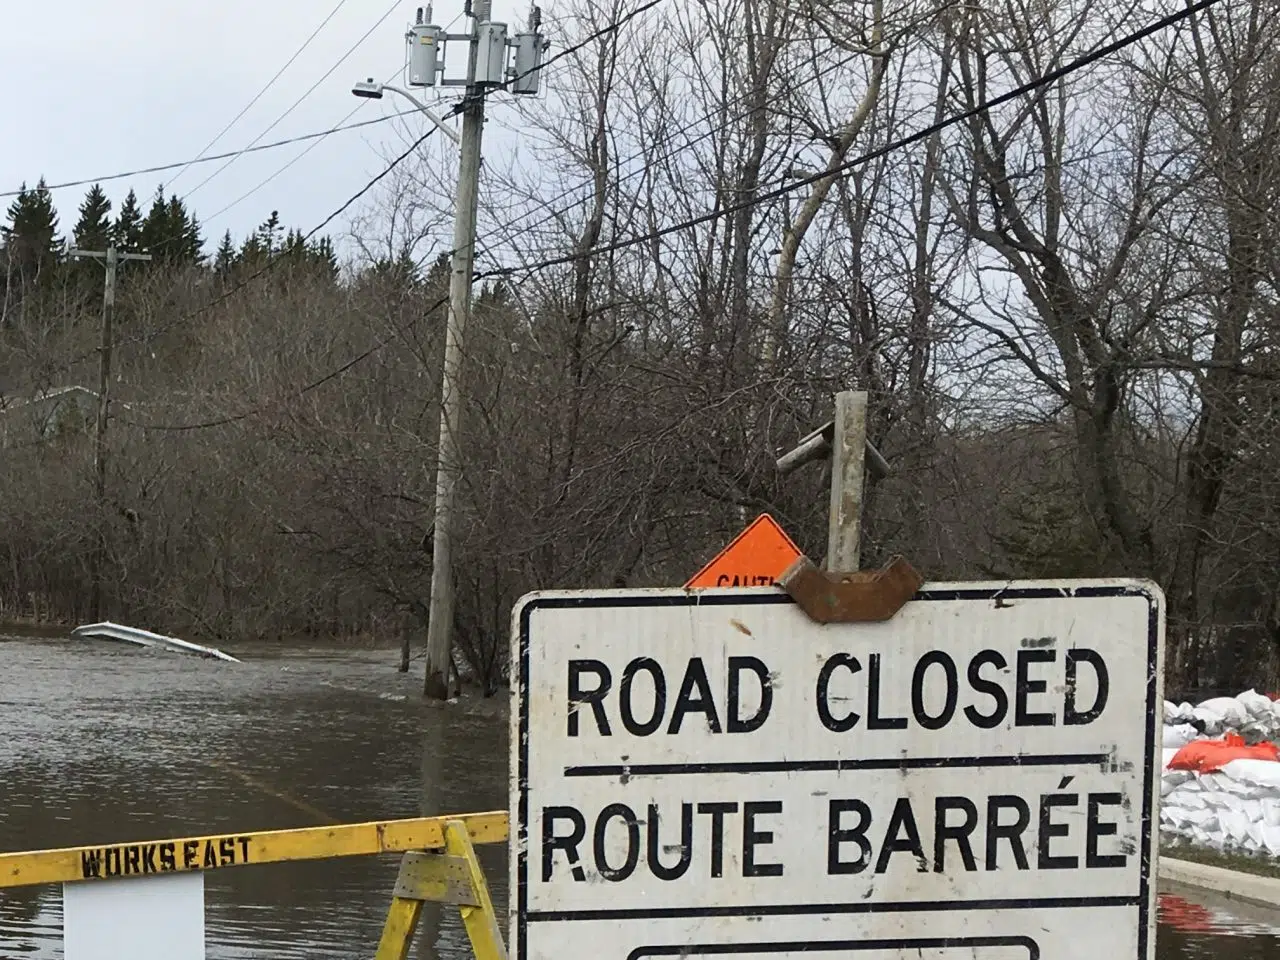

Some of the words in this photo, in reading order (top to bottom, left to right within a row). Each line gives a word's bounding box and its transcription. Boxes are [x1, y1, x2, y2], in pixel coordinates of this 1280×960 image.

[567, 655, 773, 737] ROAD
[815, 648, 1110, 734] CLOSED
[81, 842, 176, 879] WORKS
[183, 837, 252, 869] EAST
[541, 800, 785, 883] ROUTE
[827, 775, 1128, 876] BARRÉE
